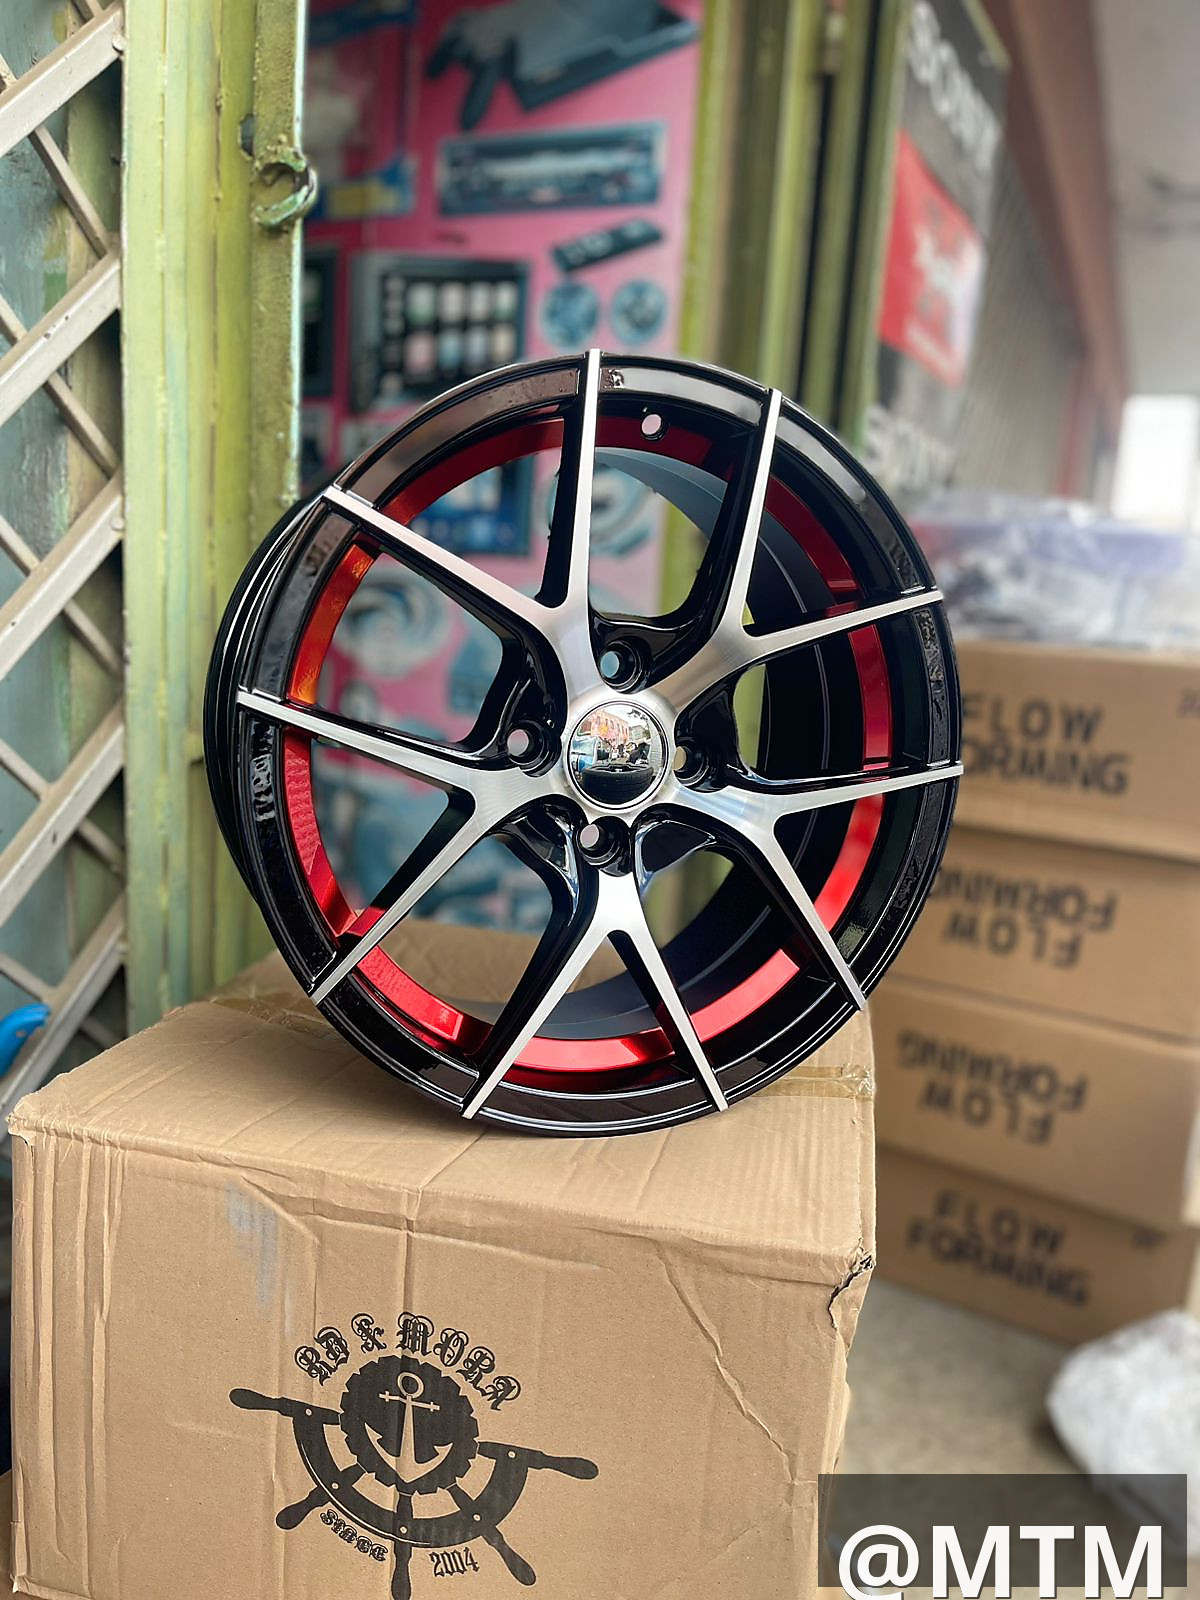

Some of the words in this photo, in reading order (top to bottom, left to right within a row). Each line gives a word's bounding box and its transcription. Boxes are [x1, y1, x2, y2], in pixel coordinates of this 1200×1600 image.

[961, 691, 1104, 745] FLOW
[961, 738, 1131, 796] ORMING
[940, 913, 1082, 970] FLOW
[897, 1028, 1089, 1113] FORMING
[917, 1081, 1055, 1145] FLOW
[933, 1187, 1067, 1256] FLOW
[906, 1216, 1092, 1307] FORMING
[429, 1546, 480, 1577] 2004
